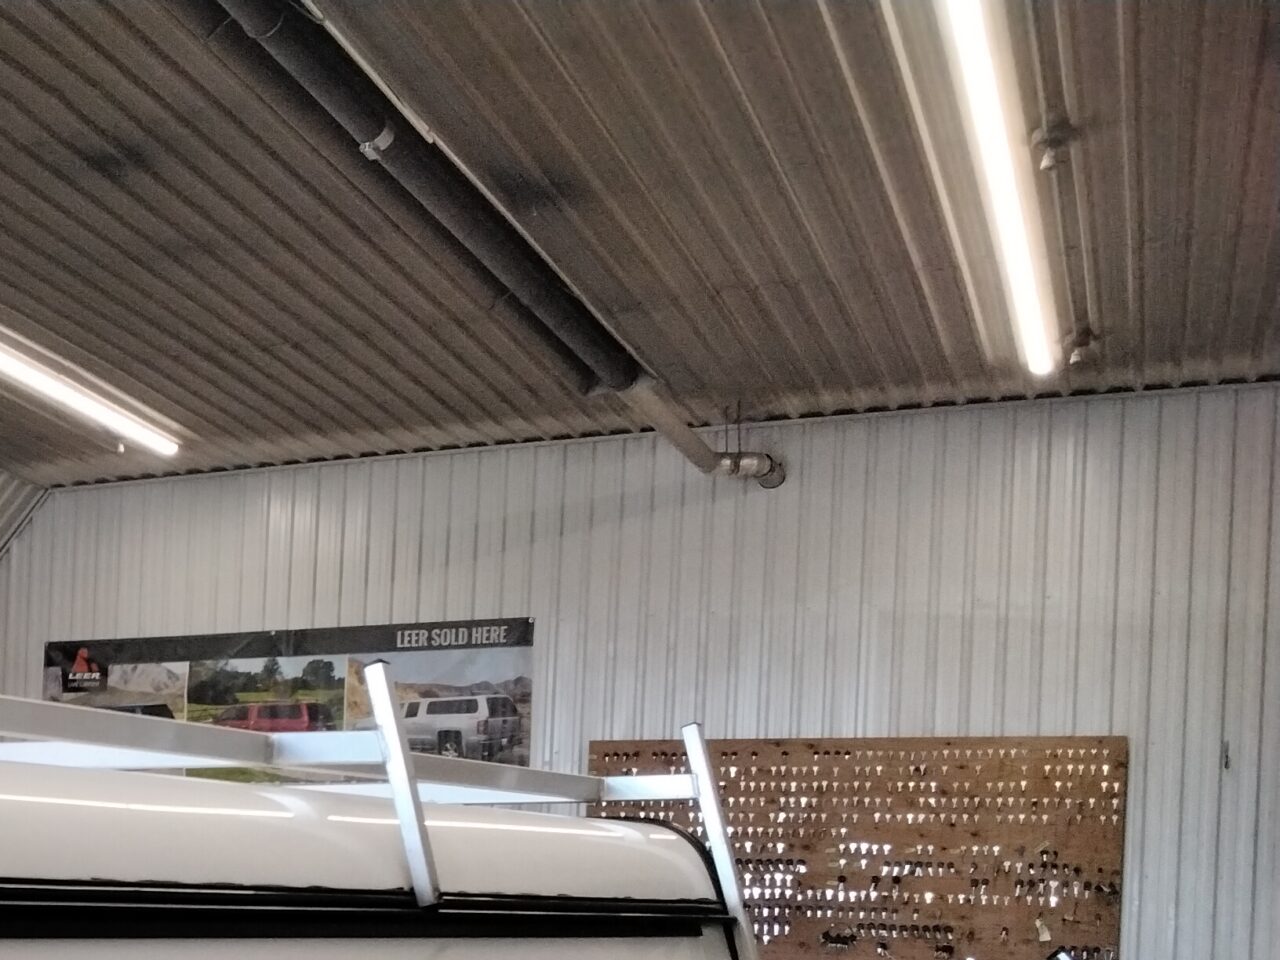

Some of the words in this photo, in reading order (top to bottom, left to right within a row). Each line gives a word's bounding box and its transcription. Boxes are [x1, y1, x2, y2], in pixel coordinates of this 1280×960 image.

[396, 630, 428, 648] LEER
[431, 627, 468, 646] SOLD
[472, 626, 508, 644] HERE
[68, 672, 101, 680] LEER
